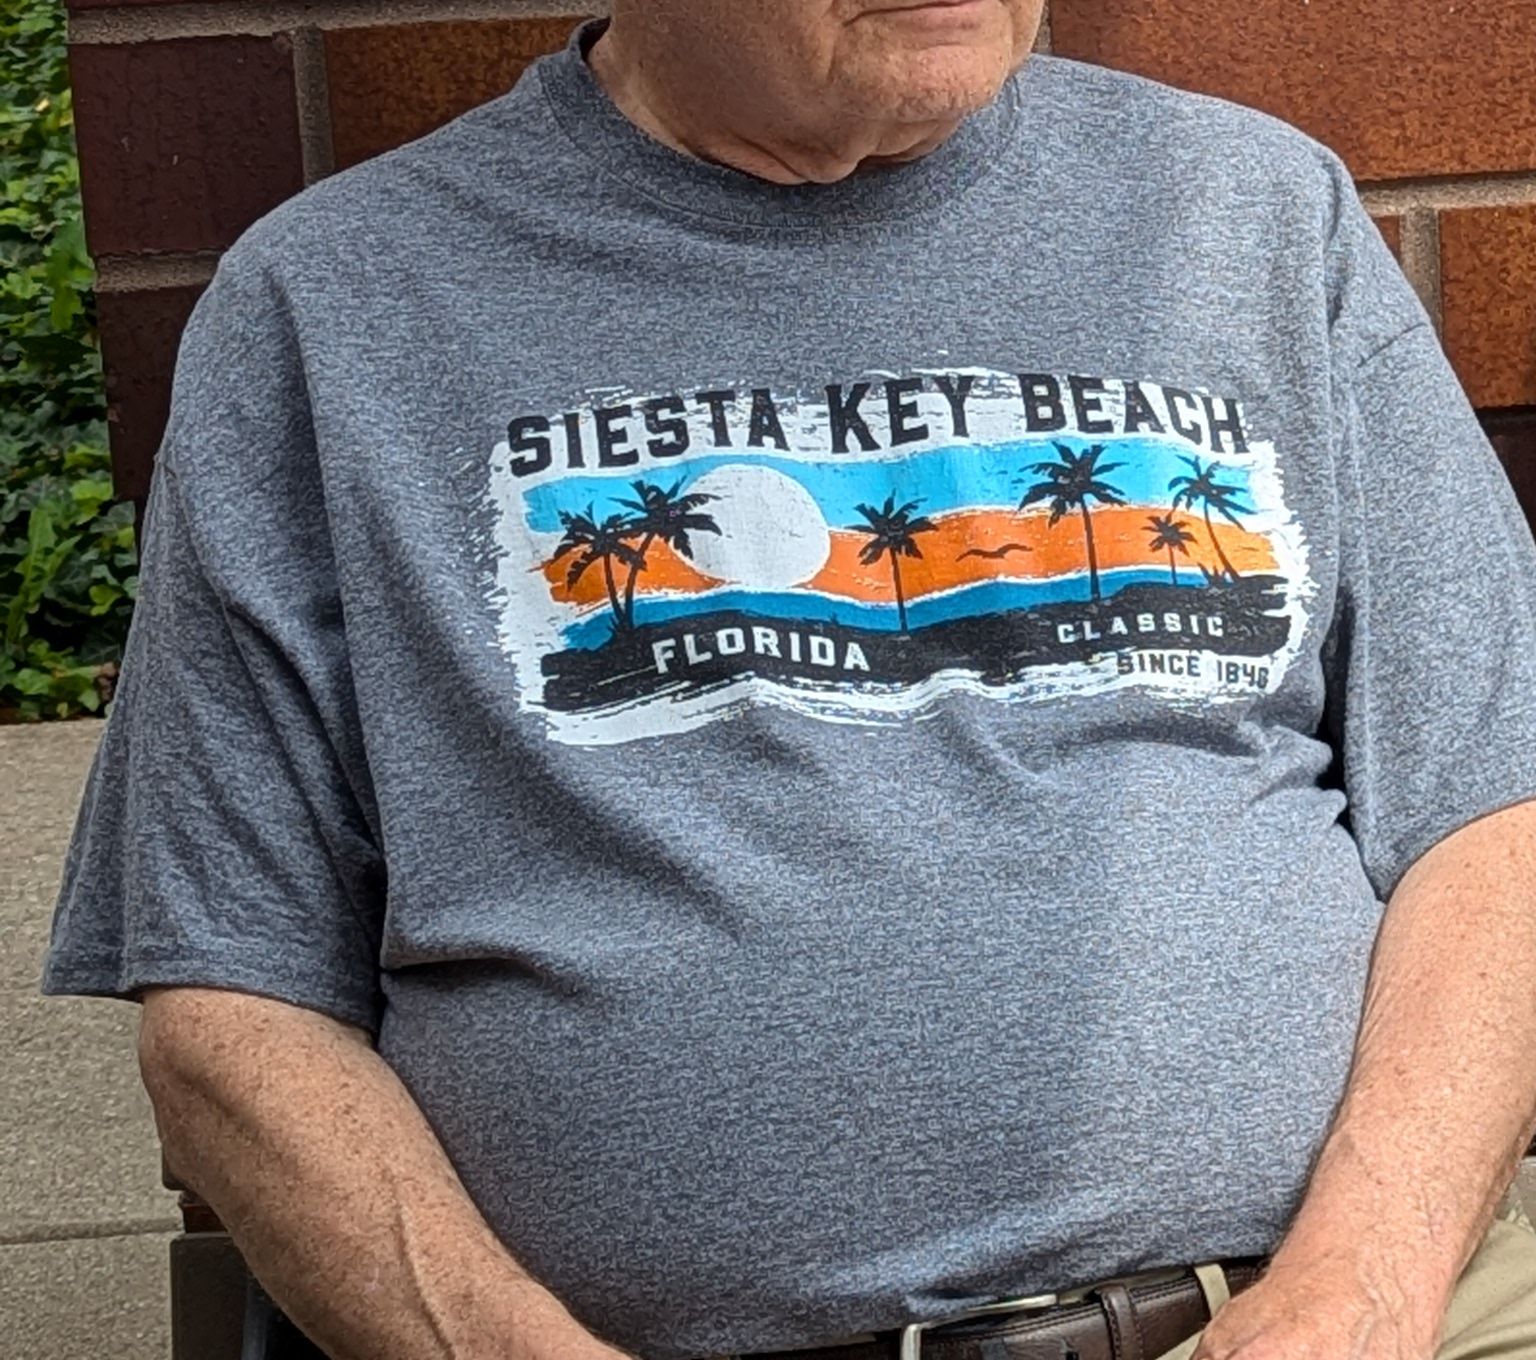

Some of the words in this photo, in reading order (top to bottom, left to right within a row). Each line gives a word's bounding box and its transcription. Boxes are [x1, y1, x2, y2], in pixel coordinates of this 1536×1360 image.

[507, 389, 791, 477] SIESTA
[825, 375, 975, 454] KEY
[1018, 373, 1250, 454] BEACH
[1057, 613, 1224, 643] CLASSIC
[652, 626, 871, 674] FLORIDA
[1117, 652, 1201, 677] SINCE
